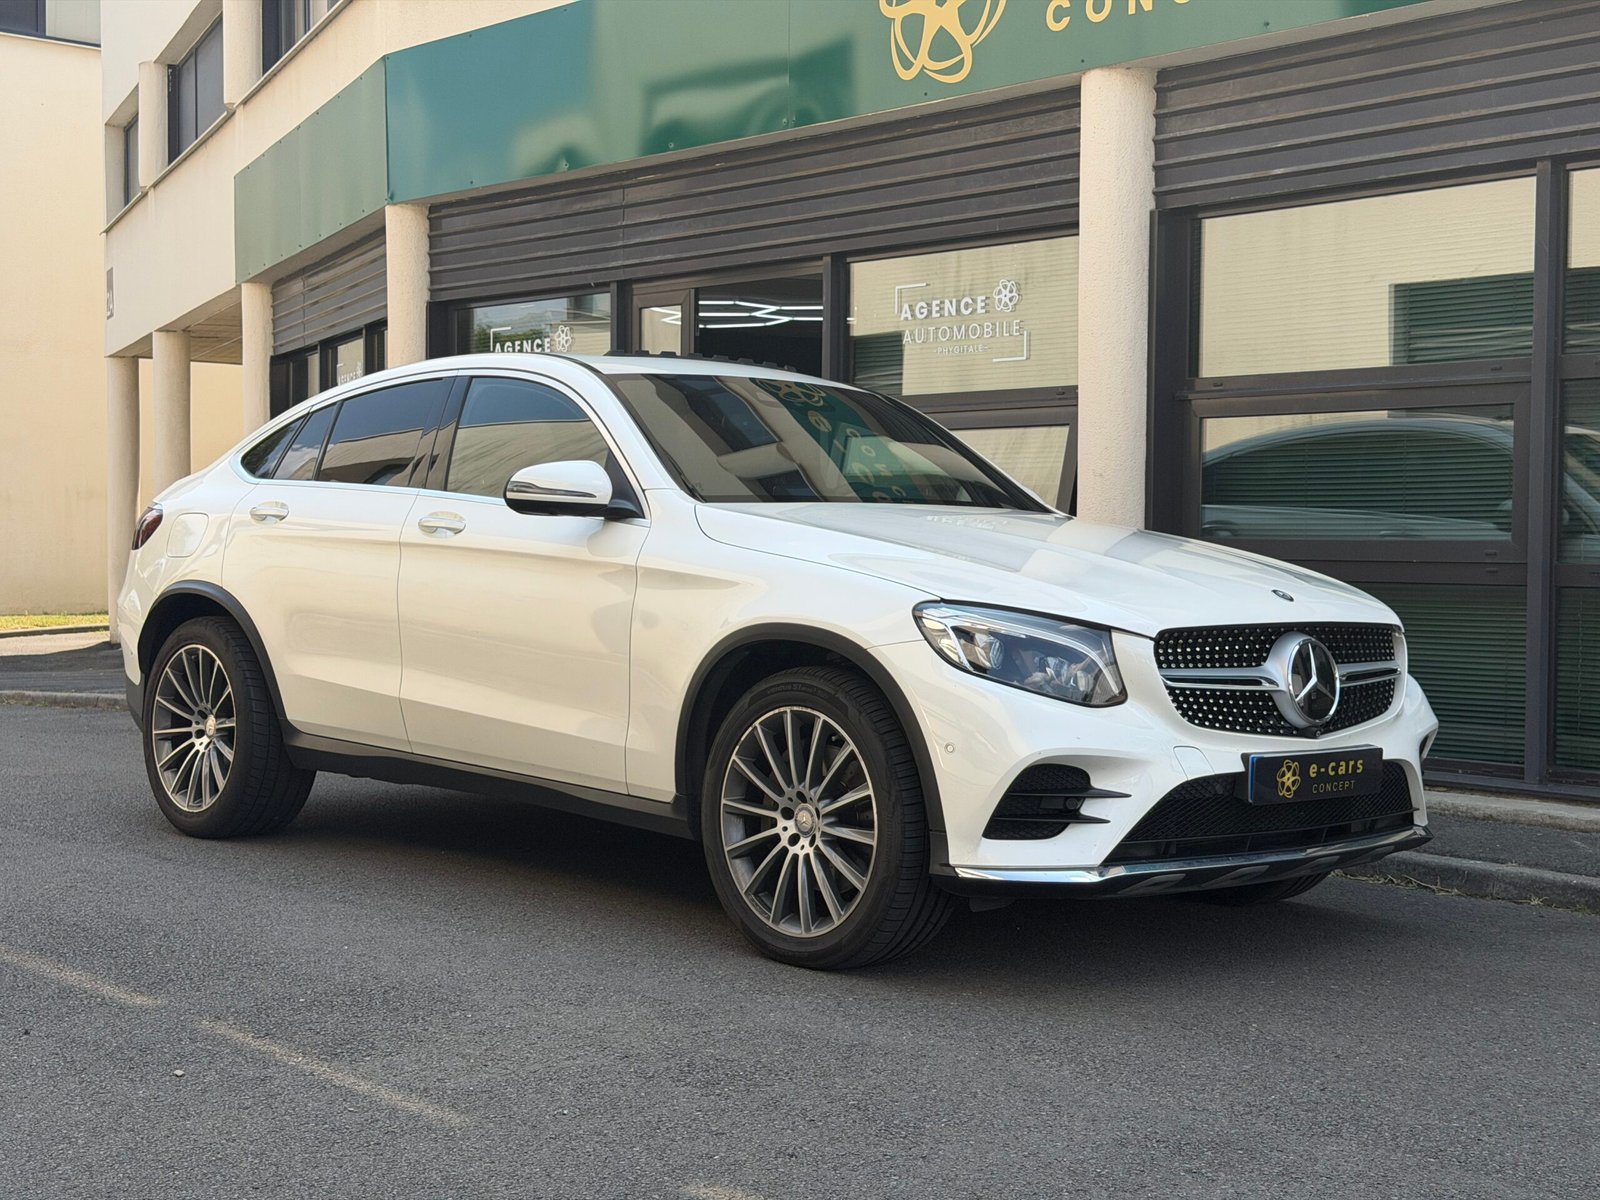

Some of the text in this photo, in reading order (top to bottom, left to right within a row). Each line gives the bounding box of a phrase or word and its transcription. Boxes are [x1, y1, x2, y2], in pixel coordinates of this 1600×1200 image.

[900, 295, 987, 321] AGENCE
[902, 319, 1021, 345] AUTOMOBILE
[1309, 759, 1364, 778] e-cars
[1312, 780, 1356, 794] CONCEPT
